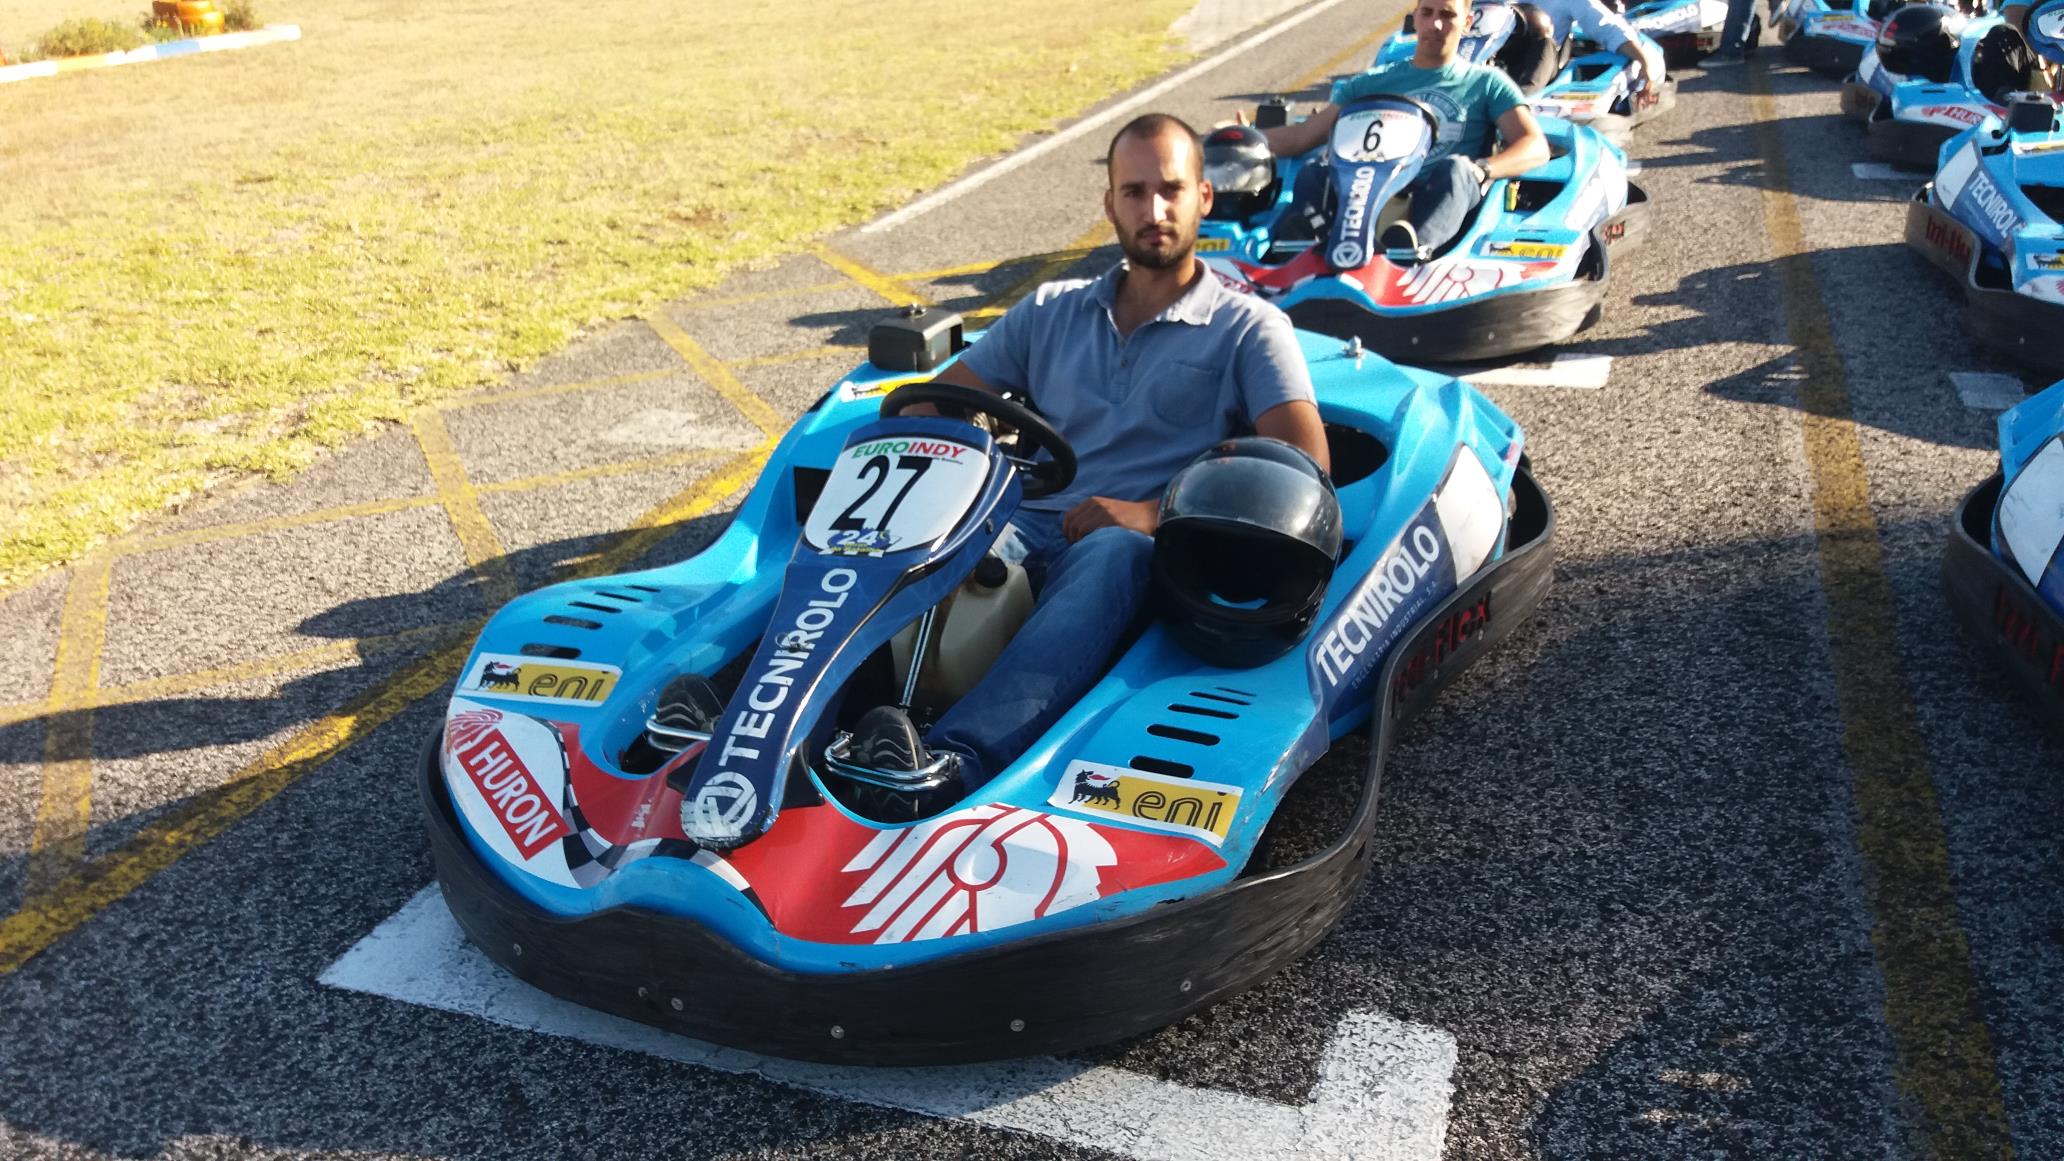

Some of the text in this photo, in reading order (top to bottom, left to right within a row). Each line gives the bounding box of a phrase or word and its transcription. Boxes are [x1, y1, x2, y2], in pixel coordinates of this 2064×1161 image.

[1363, 119, 1383, 153] 6
[852, 441, 968, 459] EUROINDY
[829, 455, 932, 531] 27
[1316, 525, 1439, 687] TECNIROLO
[528, 671, 609, 701] eni
[718, 568, 857, 766] TECNIROLO
[468, 741, 558, 848] HURON
[1132, 790, 1230, 832] eni
